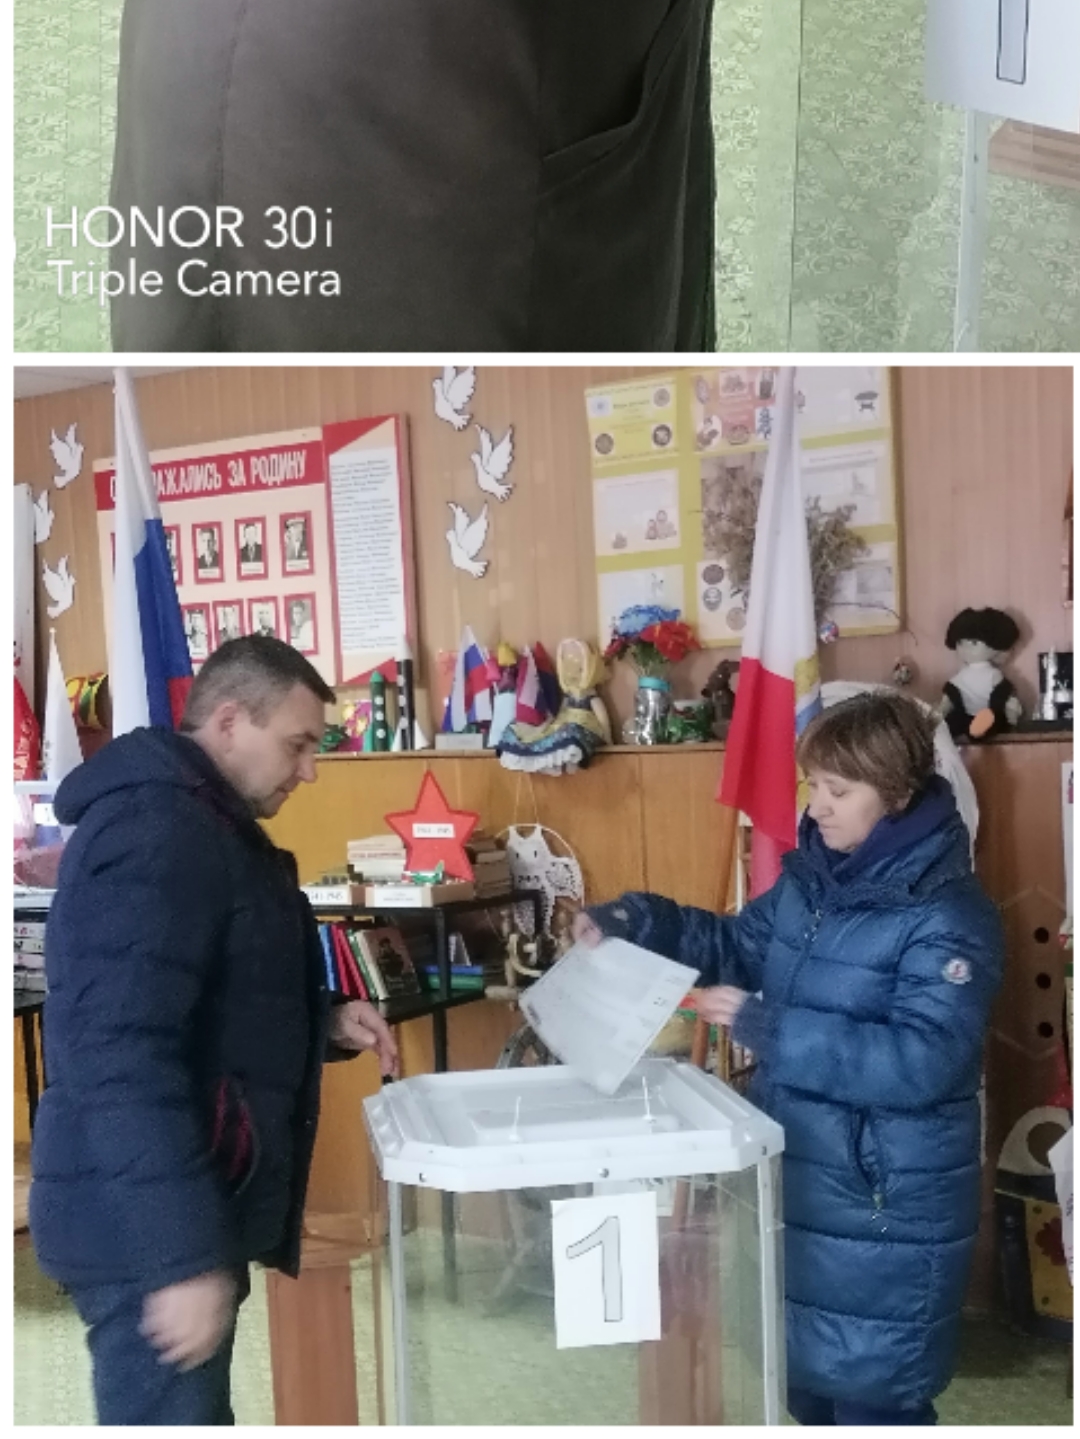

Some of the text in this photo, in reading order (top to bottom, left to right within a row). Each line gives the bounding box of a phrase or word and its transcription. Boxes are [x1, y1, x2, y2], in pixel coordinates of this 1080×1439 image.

[152, 463, 222, 496] АЖАЛИСЬ
[228, 458, 247, 487] ЗА
[251, 449, 307, 486] РОДИНУ
[565, 1215, 623, 1322] 1
